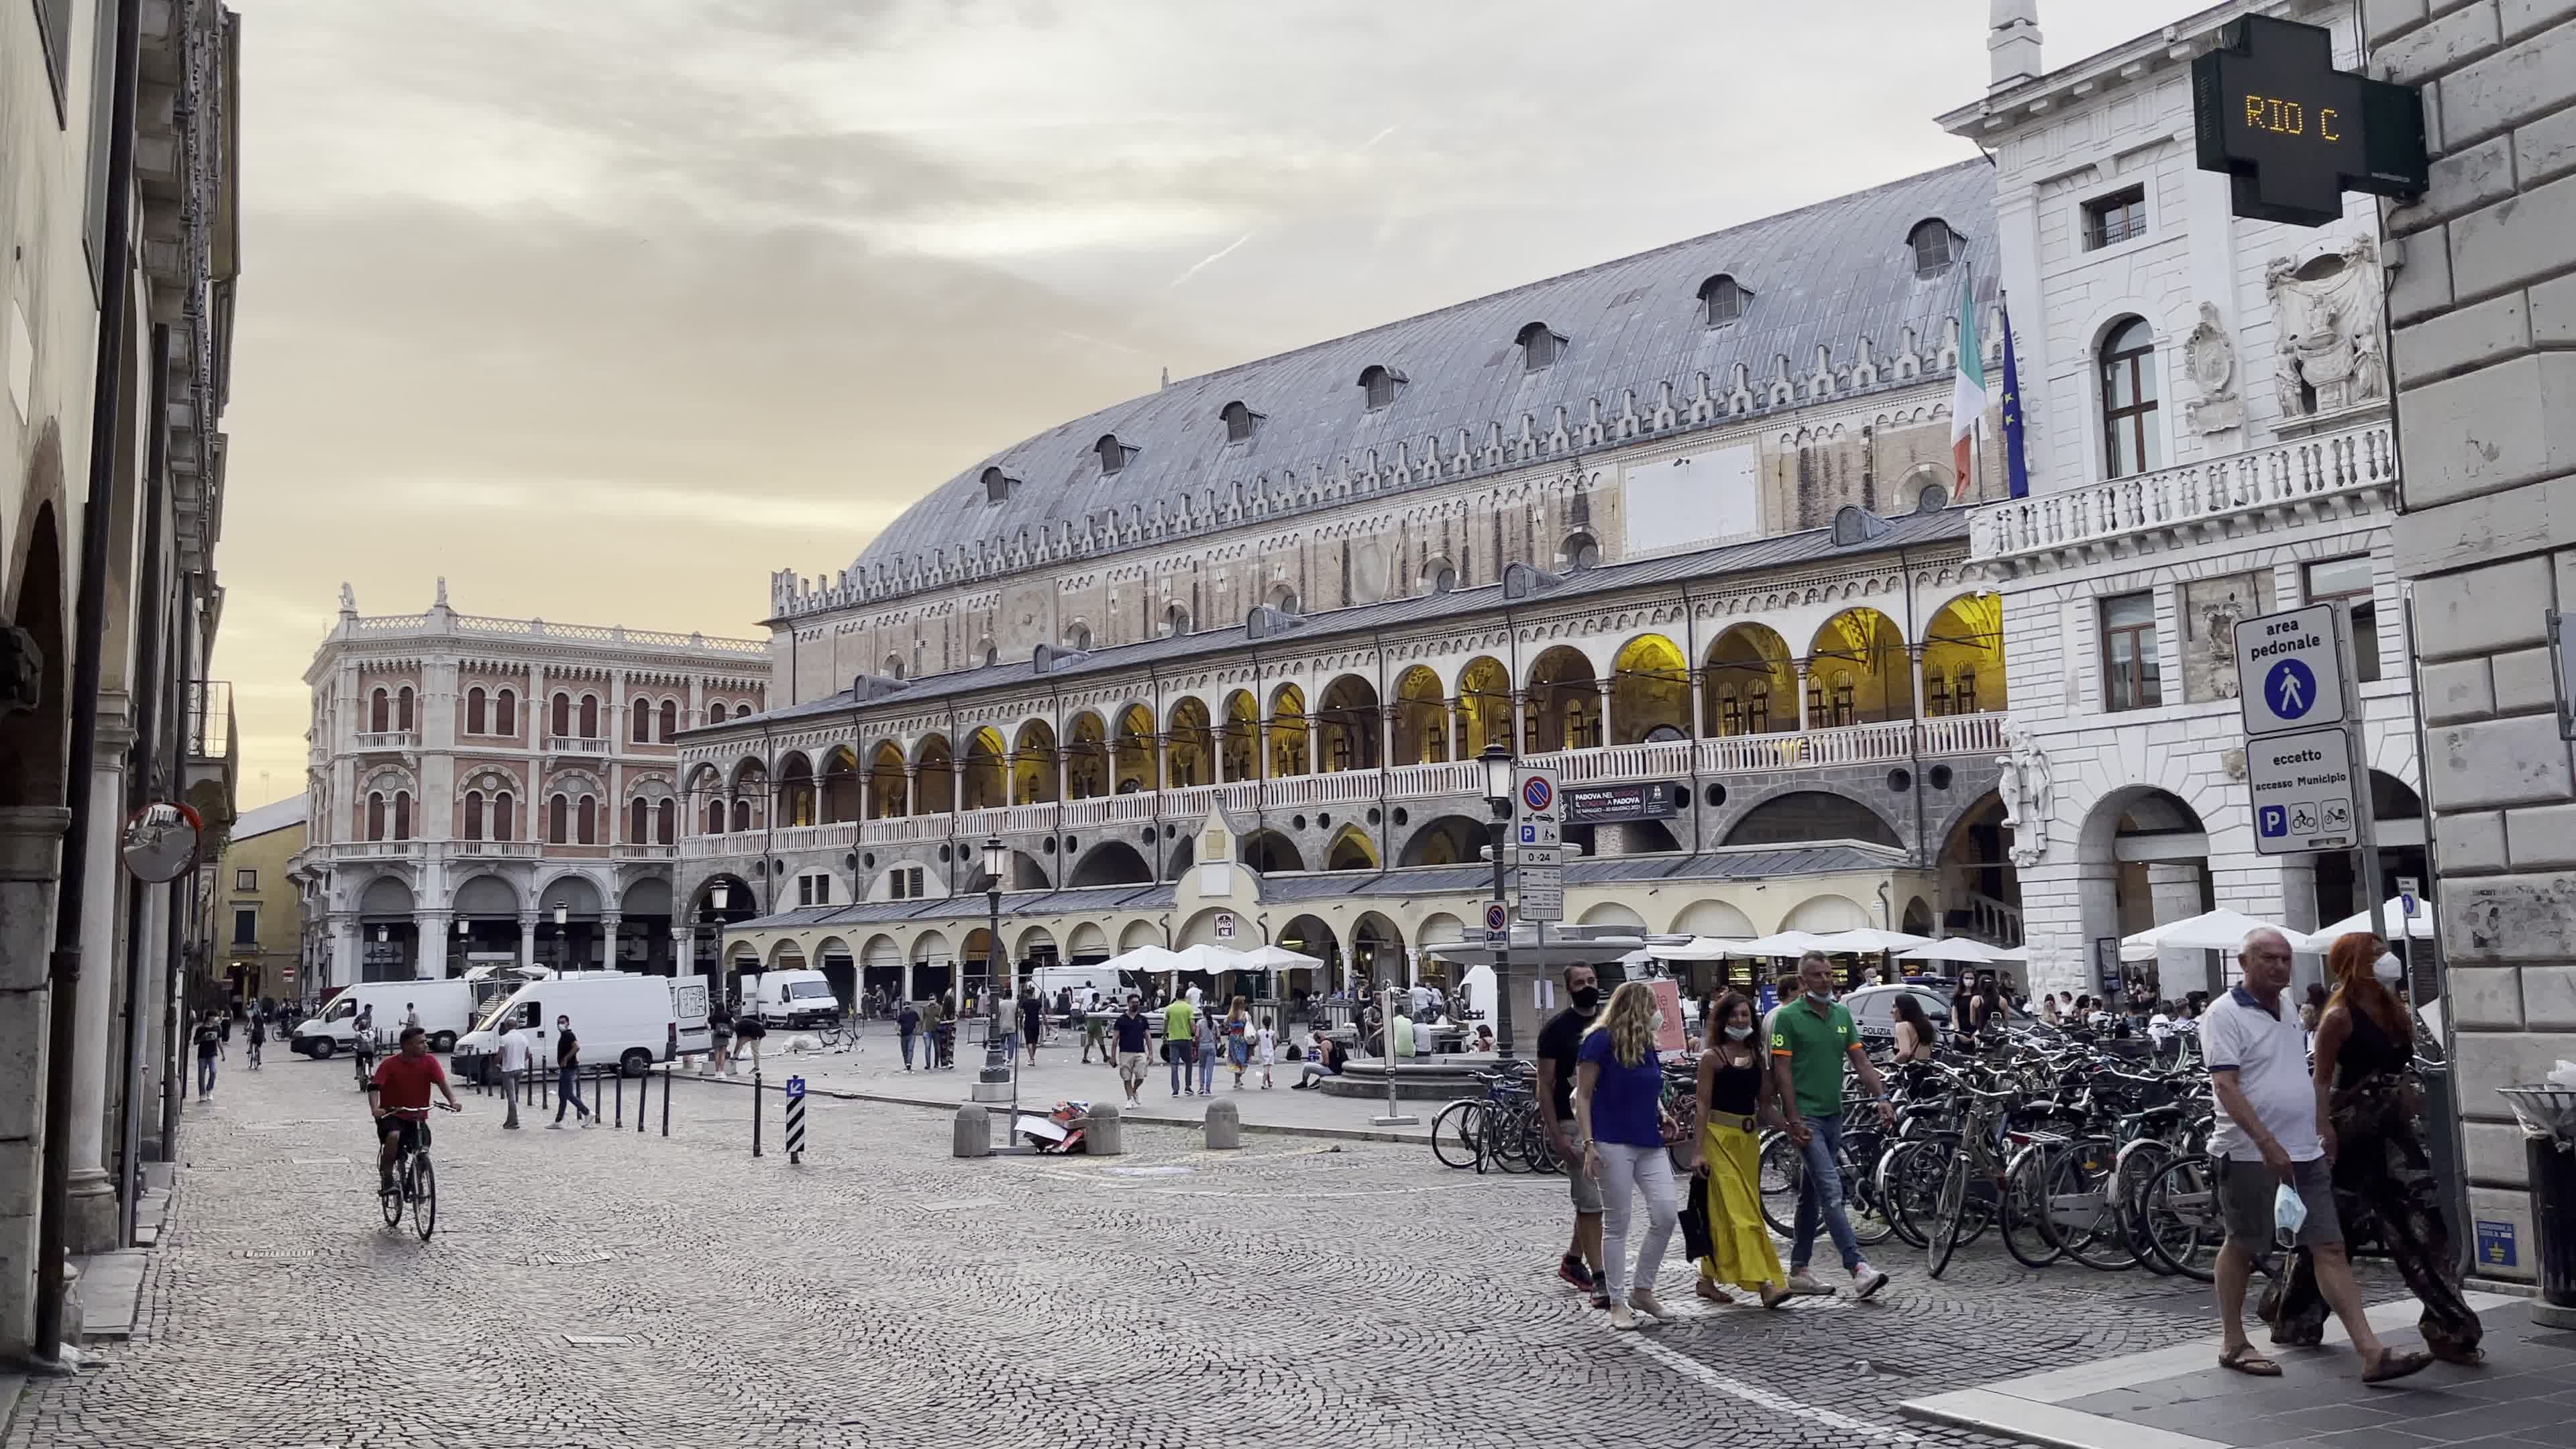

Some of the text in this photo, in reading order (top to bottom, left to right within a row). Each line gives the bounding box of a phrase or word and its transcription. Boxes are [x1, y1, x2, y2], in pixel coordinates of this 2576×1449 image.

[2246, 95, 2339, 140] RIO C
[2266, 620, 2299, 635] area
[2251, 633, 2320, 661] pedonale
[2273, 749, 2322, 765] eccetto
[2255, 773, 2347, 791] accesso Municipio
[1613, 797, 1640, 805] PADOVA
[2267, 811, 2279, 832] P
[1863, 1026, 1891, 1036] POLIZIA
